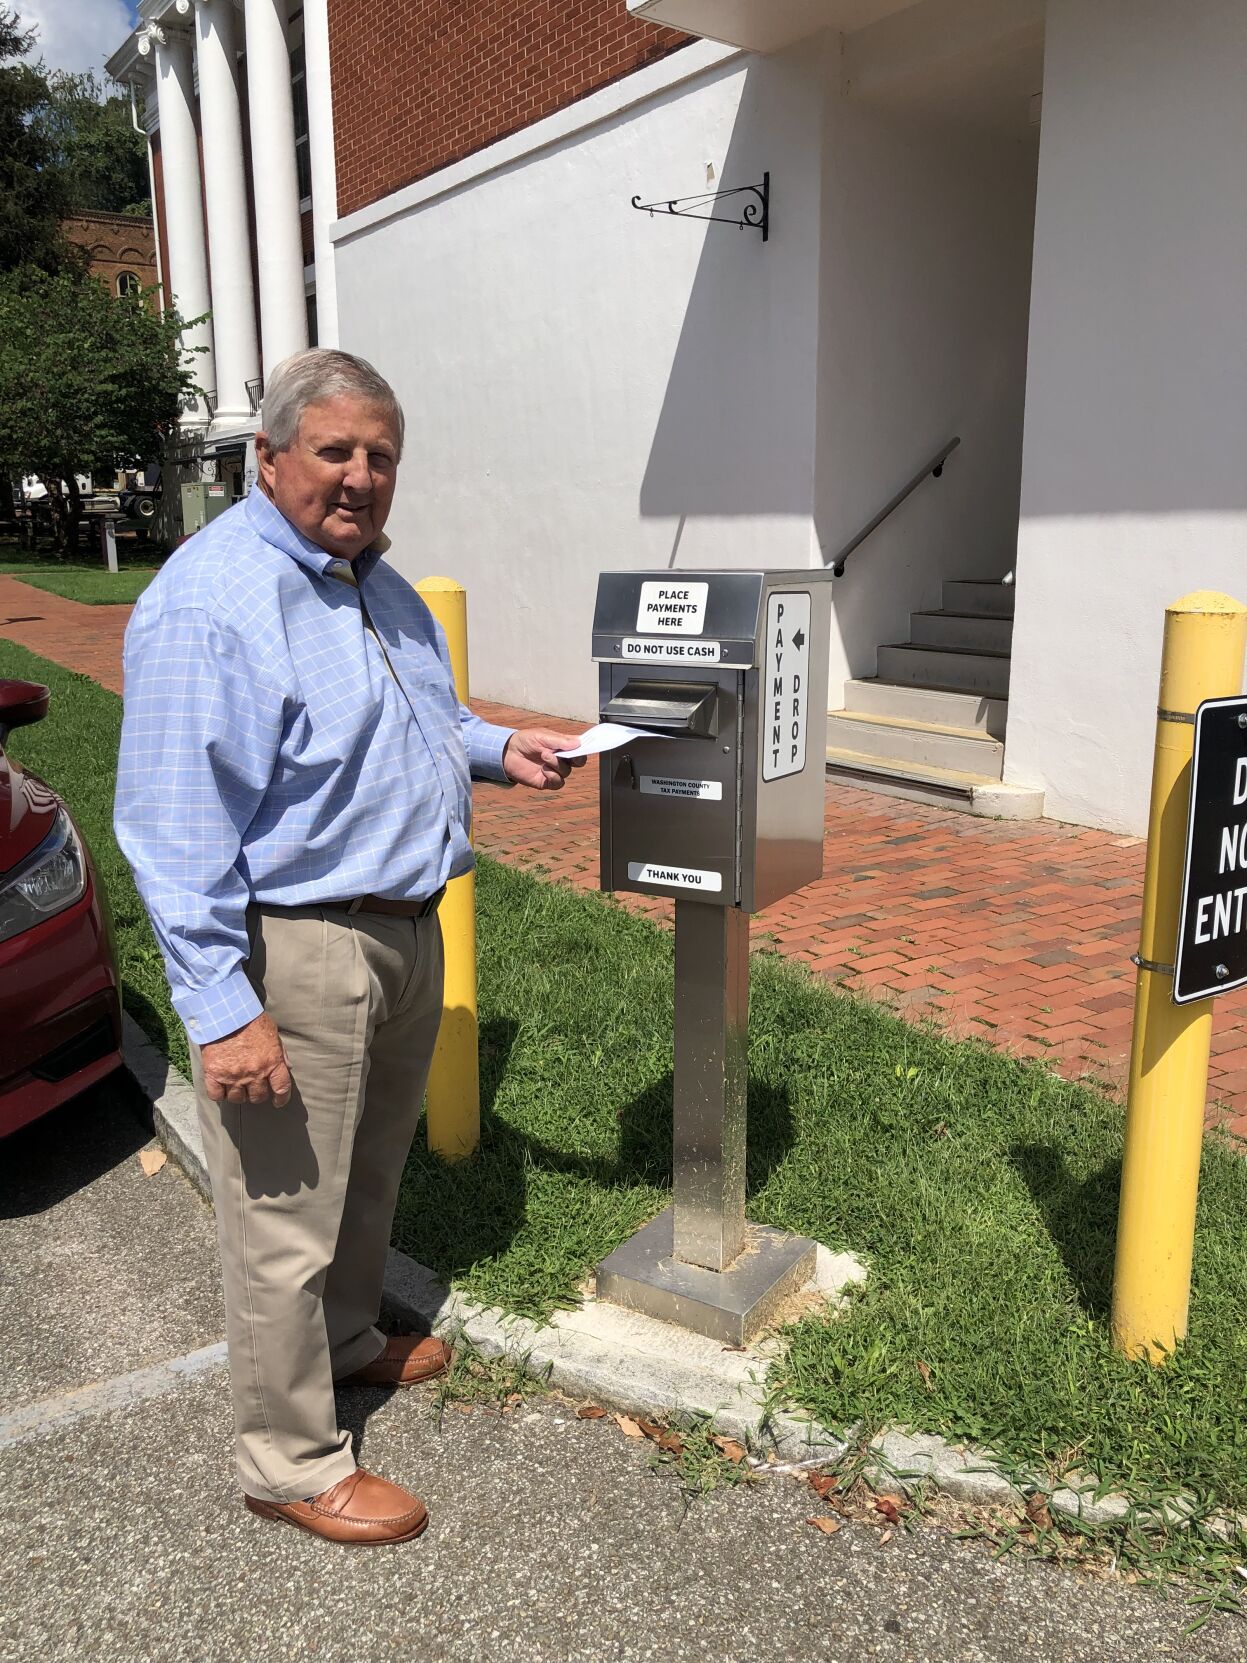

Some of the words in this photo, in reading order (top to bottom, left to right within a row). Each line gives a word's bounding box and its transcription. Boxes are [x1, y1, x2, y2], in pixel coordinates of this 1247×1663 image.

[658, 590, 690, 600] PLACE
[646, 603, 698, 614] PAYMENTS
[657, 617, 683, 627] HERE
[627, 643, 641, 653] DO
[643, 645, 664, 655] NOT
[666, 646, 685, 656] USE
[687, 647, 715, 657] CASH
[772, 603, 785, 768] PAYMENT
[791, 674, 801, 763] DROP
[651, 779, 687, 788] WASHINGTON
[687, 782, 710, 790] COUNTY
[671, 788, 701, 797] PAYMENTS
[647, 869, 680, 882] THANK
[681, 873, 702, 884] YOU
